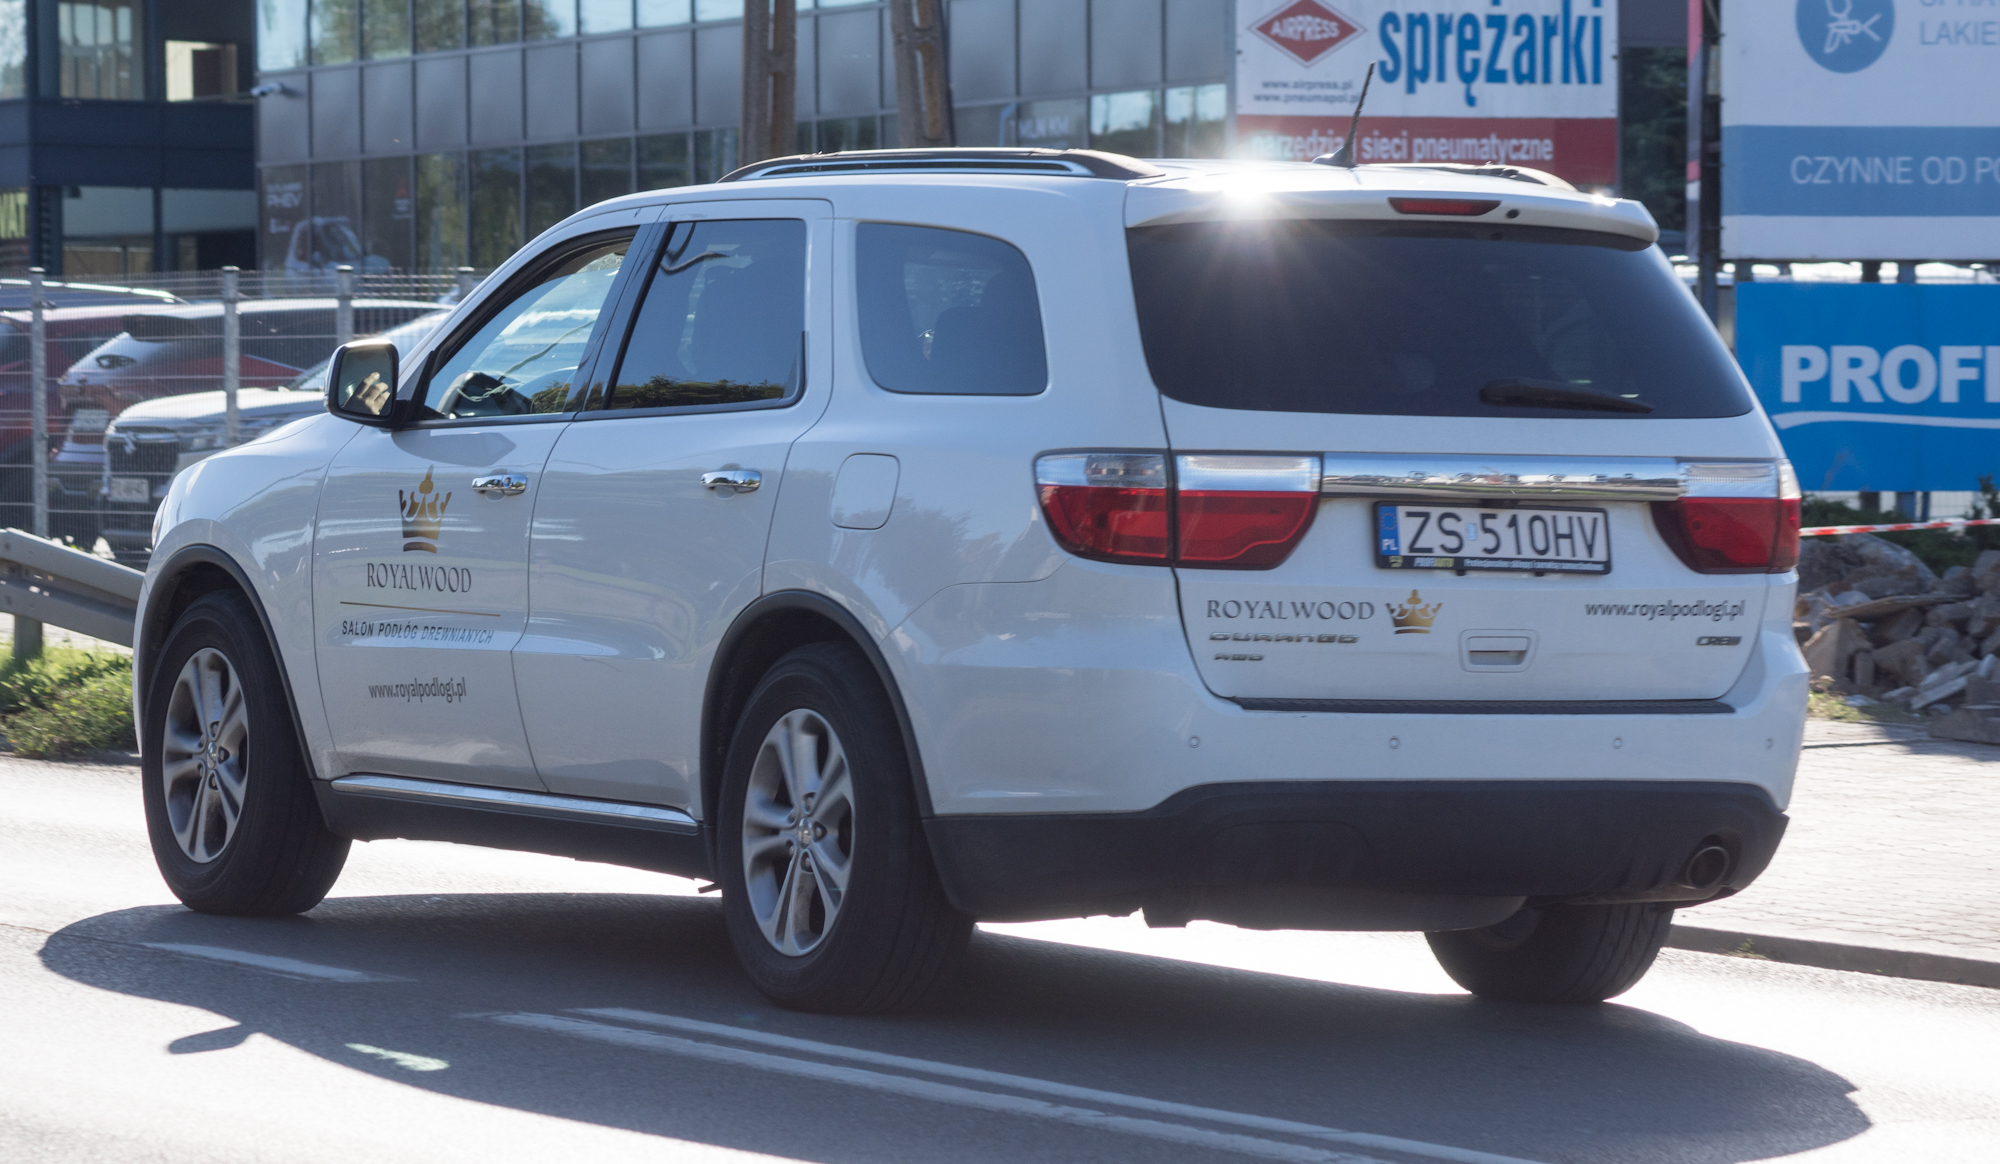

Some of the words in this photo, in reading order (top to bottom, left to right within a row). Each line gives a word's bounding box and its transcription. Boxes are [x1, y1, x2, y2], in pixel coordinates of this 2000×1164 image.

[1270, 15, 1340, 41] AIRPRESS
[1379, 0, 1602, 107] sprężarki
[1261, 80, 1352, 90] www.airpress.pl
[1361, 130, 1408, 160] sieci
[1413, 133, 1554, 166] pneumatyczne
[1790, 156, 1913, 184] CZYNNE
[1921, 156, 1967, 184] OD
[1382, 538, 1398, 550] PL
[1405, 511, 1465, 554] ZS
[1480, 513, 1599, 559] 510HV
[366, 562, 472, 593] ROYALWOOD
[1206, 599, 1375, 620] ROYALWOOD
[1585, 599, 1745, 622] www.royalpodlogi.pl
[341, 620, 374, 637] SALON
[378, 621, 418, 640] PODŁÓG
[420, 625, 495, 645] DREWNIANYCH
[1209, 631, 1360, 644] DURANGO
[368, 676, 467, 703] www.royalpodlogi.pl
